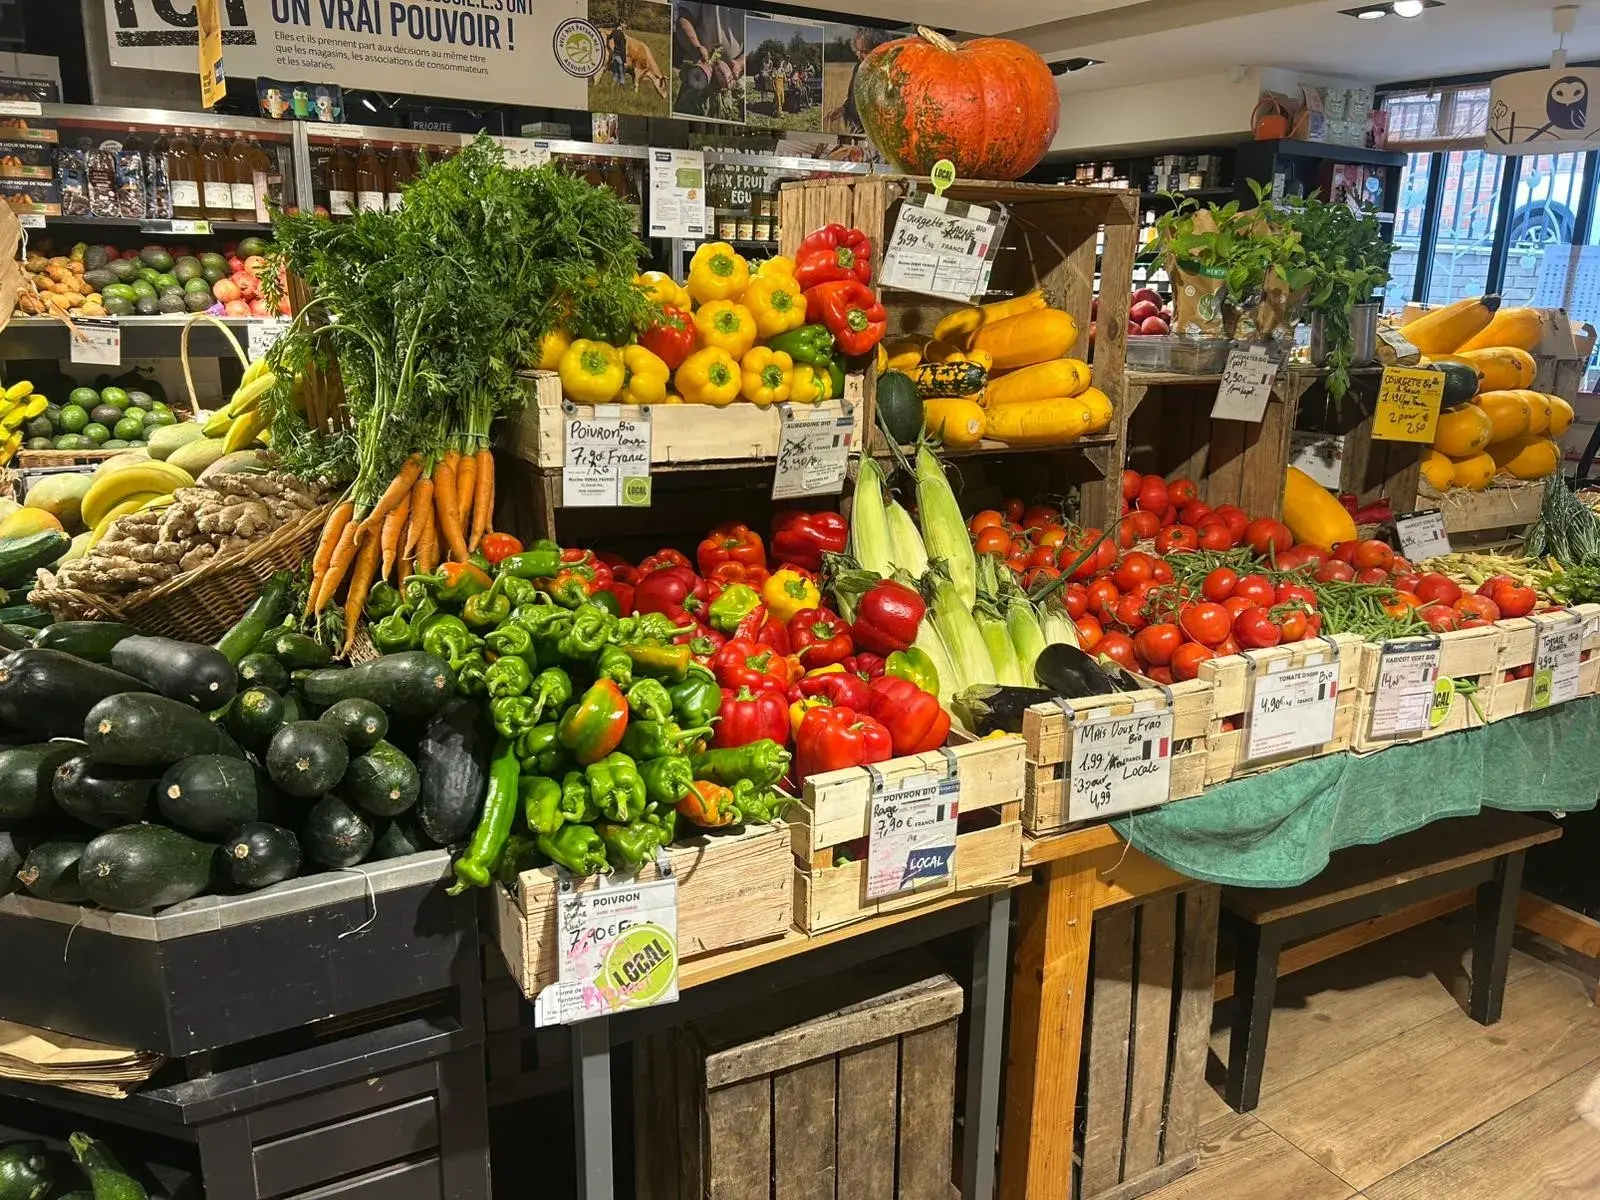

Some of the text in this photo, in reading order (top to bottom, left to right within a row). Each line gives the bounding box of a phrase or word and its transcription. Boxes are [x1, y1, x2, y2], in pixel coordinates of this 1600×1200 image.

[272, 0, 515, 51] UN VRAI POUVOIR !
[274, 30, 488, 64] Elles et ils prennent part aux décisions au même titre
[275, 45, 489, 75] que les magasins, les associations de consommateurs
[276, 57, 337, 71] et les salariés.
[933, 166, 952, 182] LOCAL
[901, 207, 944, 230] Courgette
[896, 229, 919, 247] 3,99
[941, 242, 965, 255] FRANCE
[619, 420, 636, 432] Bio
[786, 420, 820, 430] AUBERGINE
[1407, 422, 1427, 435] 2,50
[607, 449, 648, 466] France
[627, 484, 648, 498] LOCAL
[1384, 655, 1411, 664] HARICOT
[1411, 655, 1425, 663] VERT
[1279, 671, 1302, 683] TOMATE
[1296, 696, 1314, 705] FRANCE
[1112, 719, 1136, 739] Doux
[1128, 732, 1144, 746] Bio
[883, 786, 937, 804] POIVRON BIO
[1089, 790, 1112, 812] 4,99
[878, 816, 936, 839] 7,90 € FRANCE
[908, 855, 945, 872] LOCAL
[592, 892, 641, 909] POIVRON
[569, 926, 606, 953] 7,90
[606, 923, 617, 938] €
[613, 938, 672, 991] LOCAL
